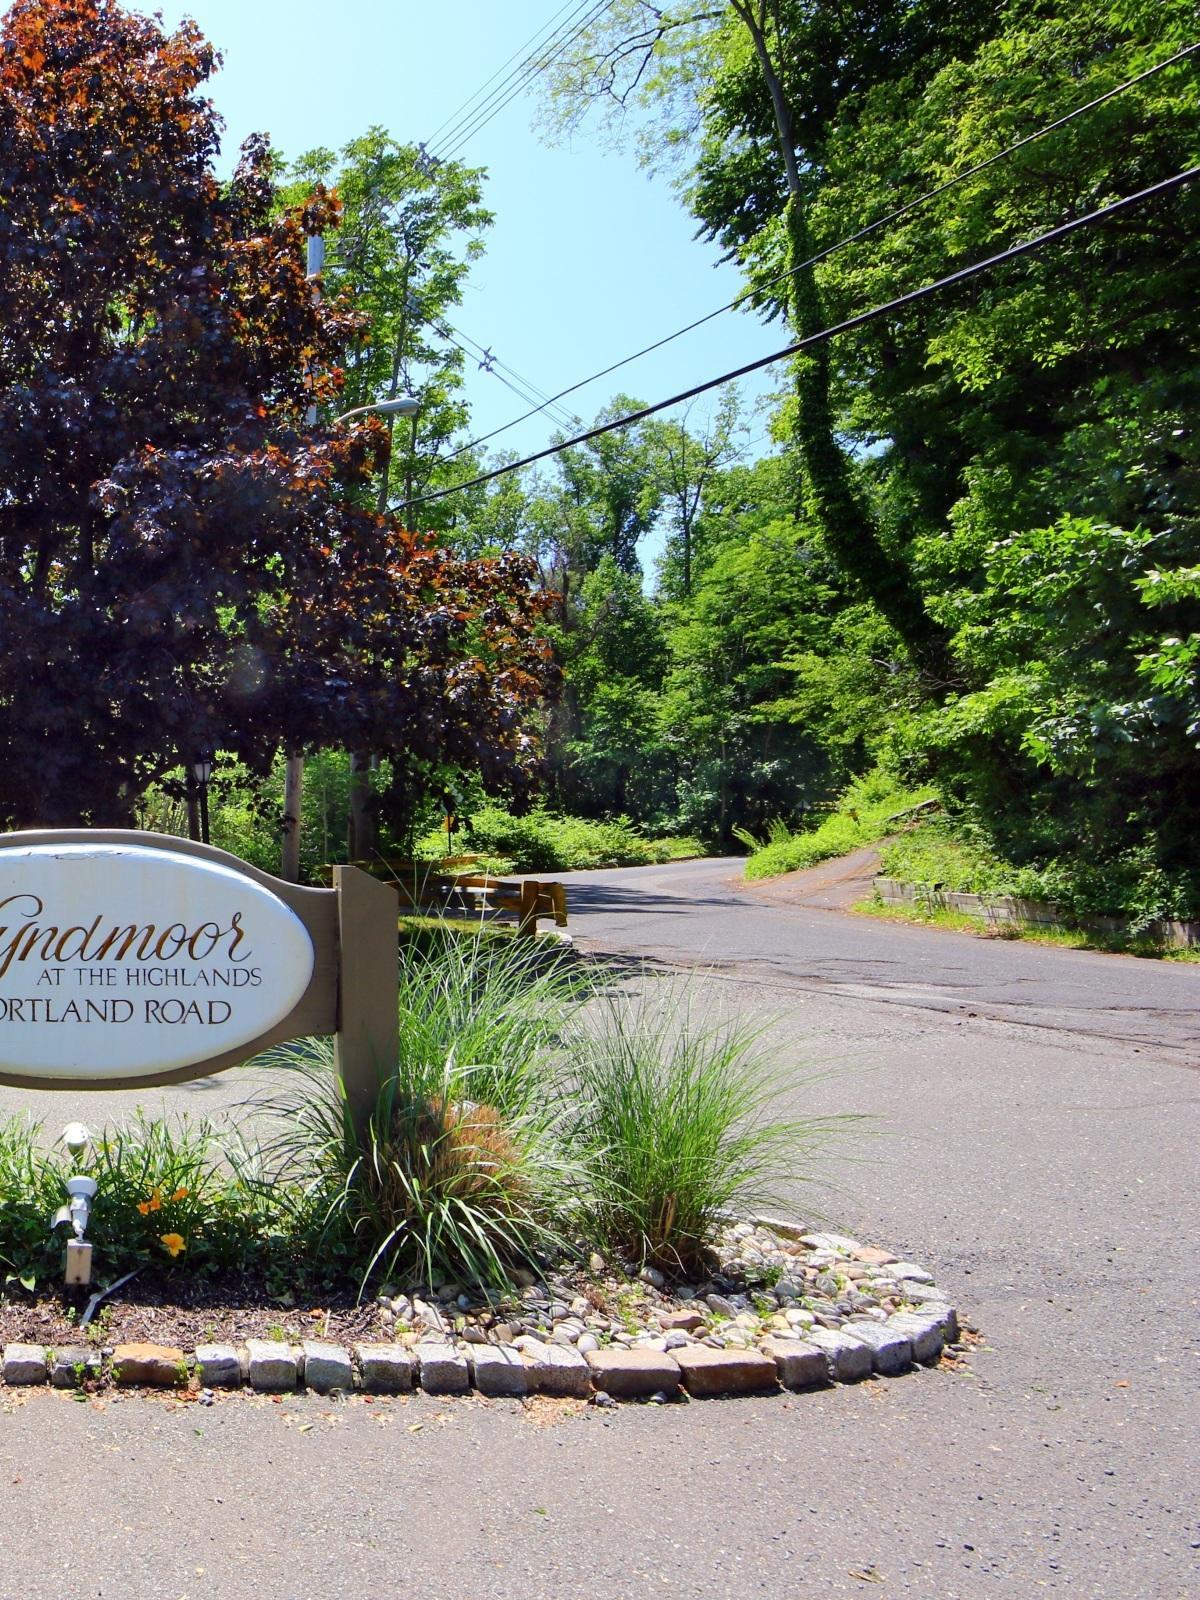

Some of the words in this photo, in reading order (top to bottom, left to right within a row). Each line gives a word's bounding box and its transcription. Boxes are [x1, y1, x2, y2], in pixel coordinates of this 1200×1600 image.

[37, 967, 66, 986] AT
[77, 967, 117, 986] THE
[126, 967, 263, 987] HIGHLANDS
[144, 998, 232, 1025] ROAD
